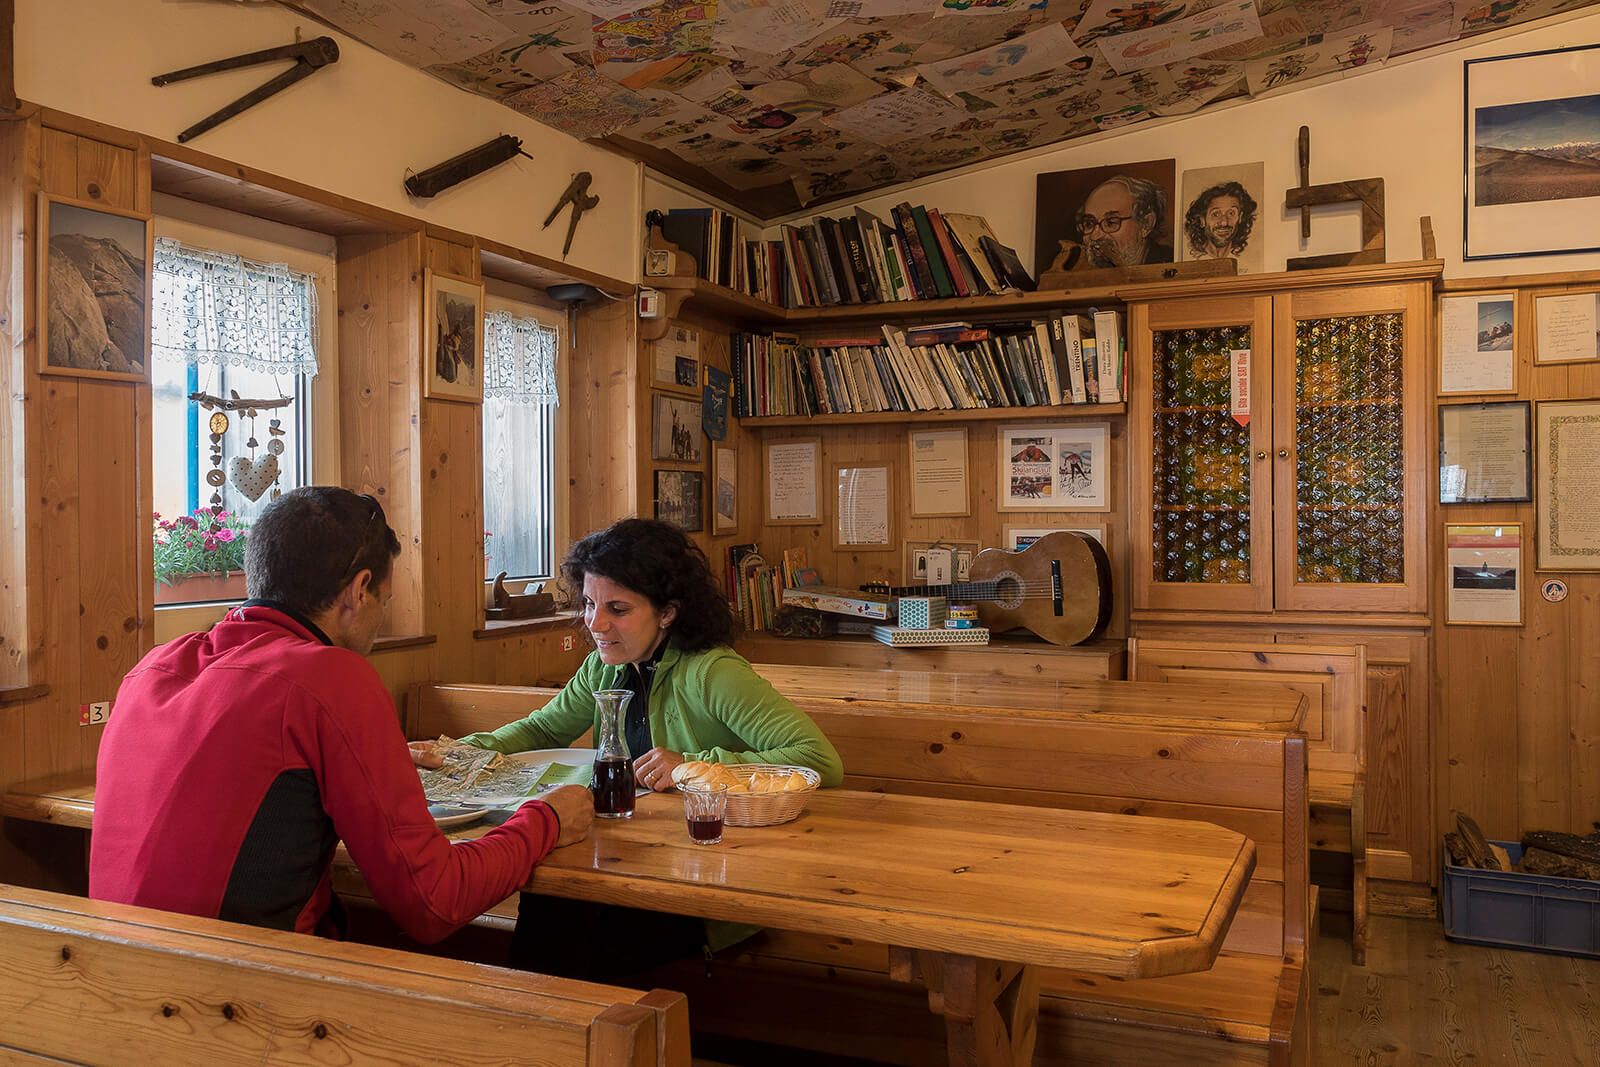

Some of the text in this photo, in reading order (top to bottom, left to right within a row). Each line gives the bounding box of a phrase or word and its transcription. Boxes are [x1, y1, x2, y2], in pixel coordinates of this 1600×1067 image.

[1073, 340, 1081, 371] TRENTINO
[565, 638, 570, 649] 2
[92, 706, 103, 722] 3
